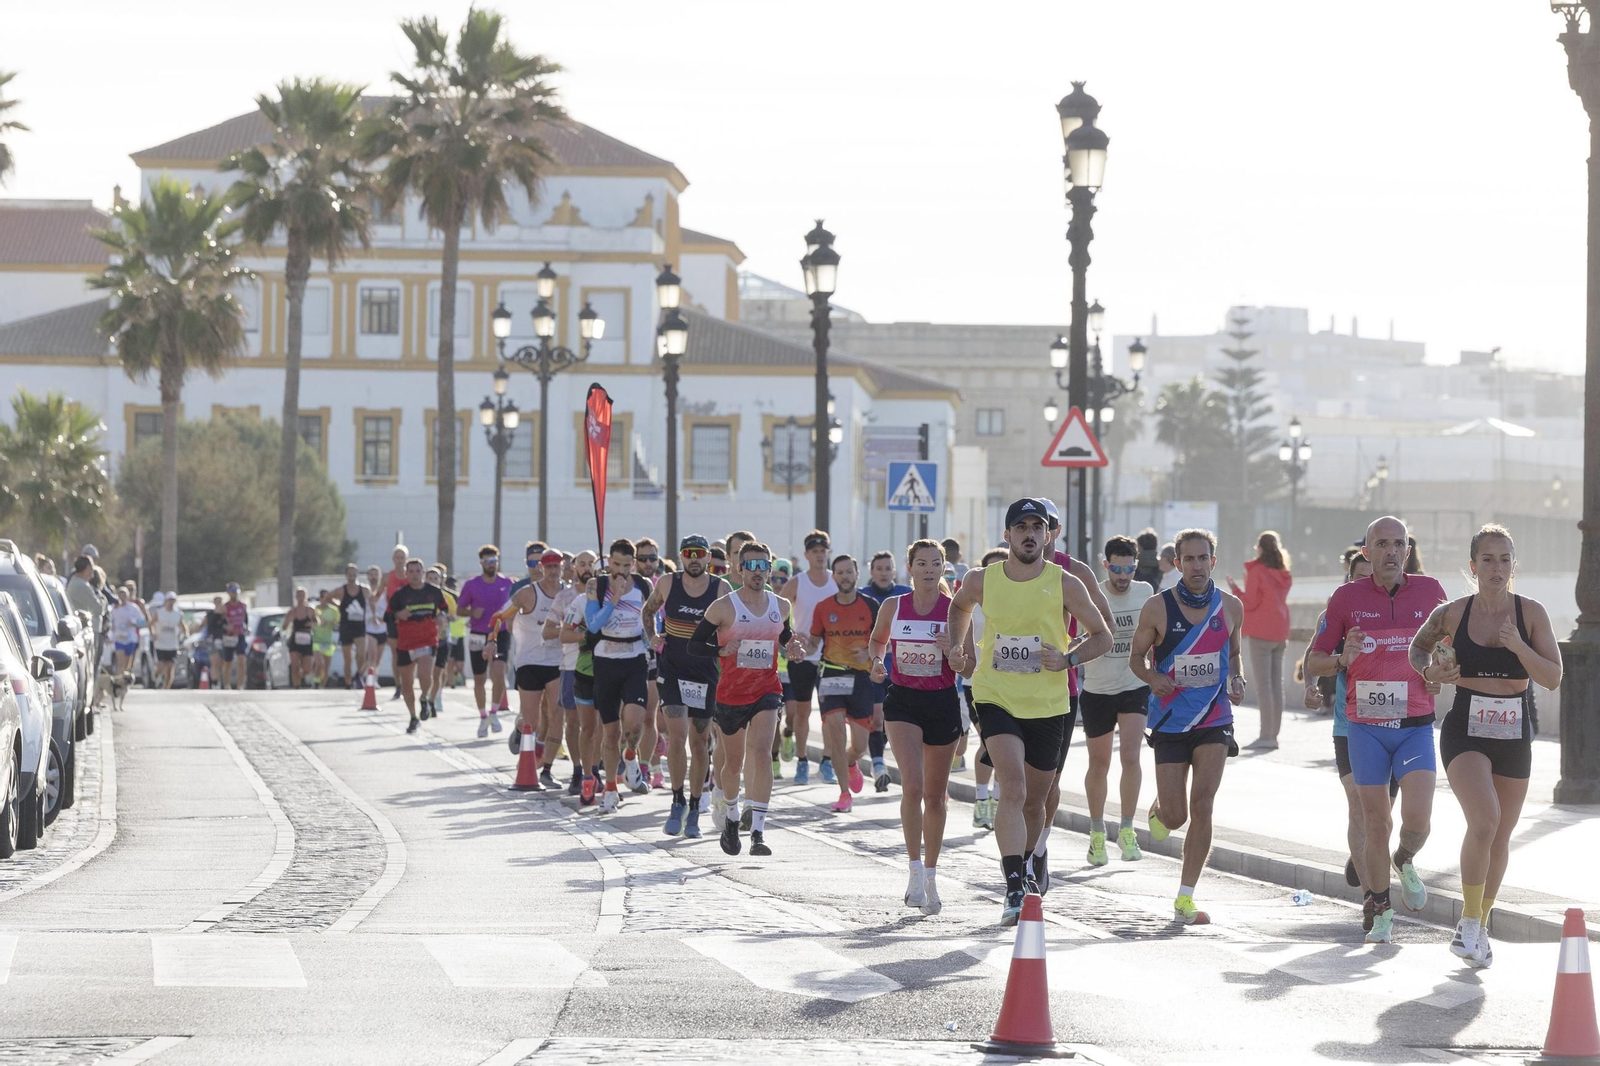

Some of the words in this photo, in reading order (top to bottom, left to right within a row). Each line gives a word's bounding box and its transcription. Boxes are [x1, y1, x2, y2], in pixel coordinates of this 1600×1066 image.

[1376, 635, 1406, 645] muebles
[746, 648, 768, 659] 486
[901, 651, 936, 666] 2282
[1001, 646, 1029, 660] 960
[1181, 662, 1214, 677] 1580
[1368, 692, 1394, 706] 591
[1477, 709, 1517, 725] 1743
